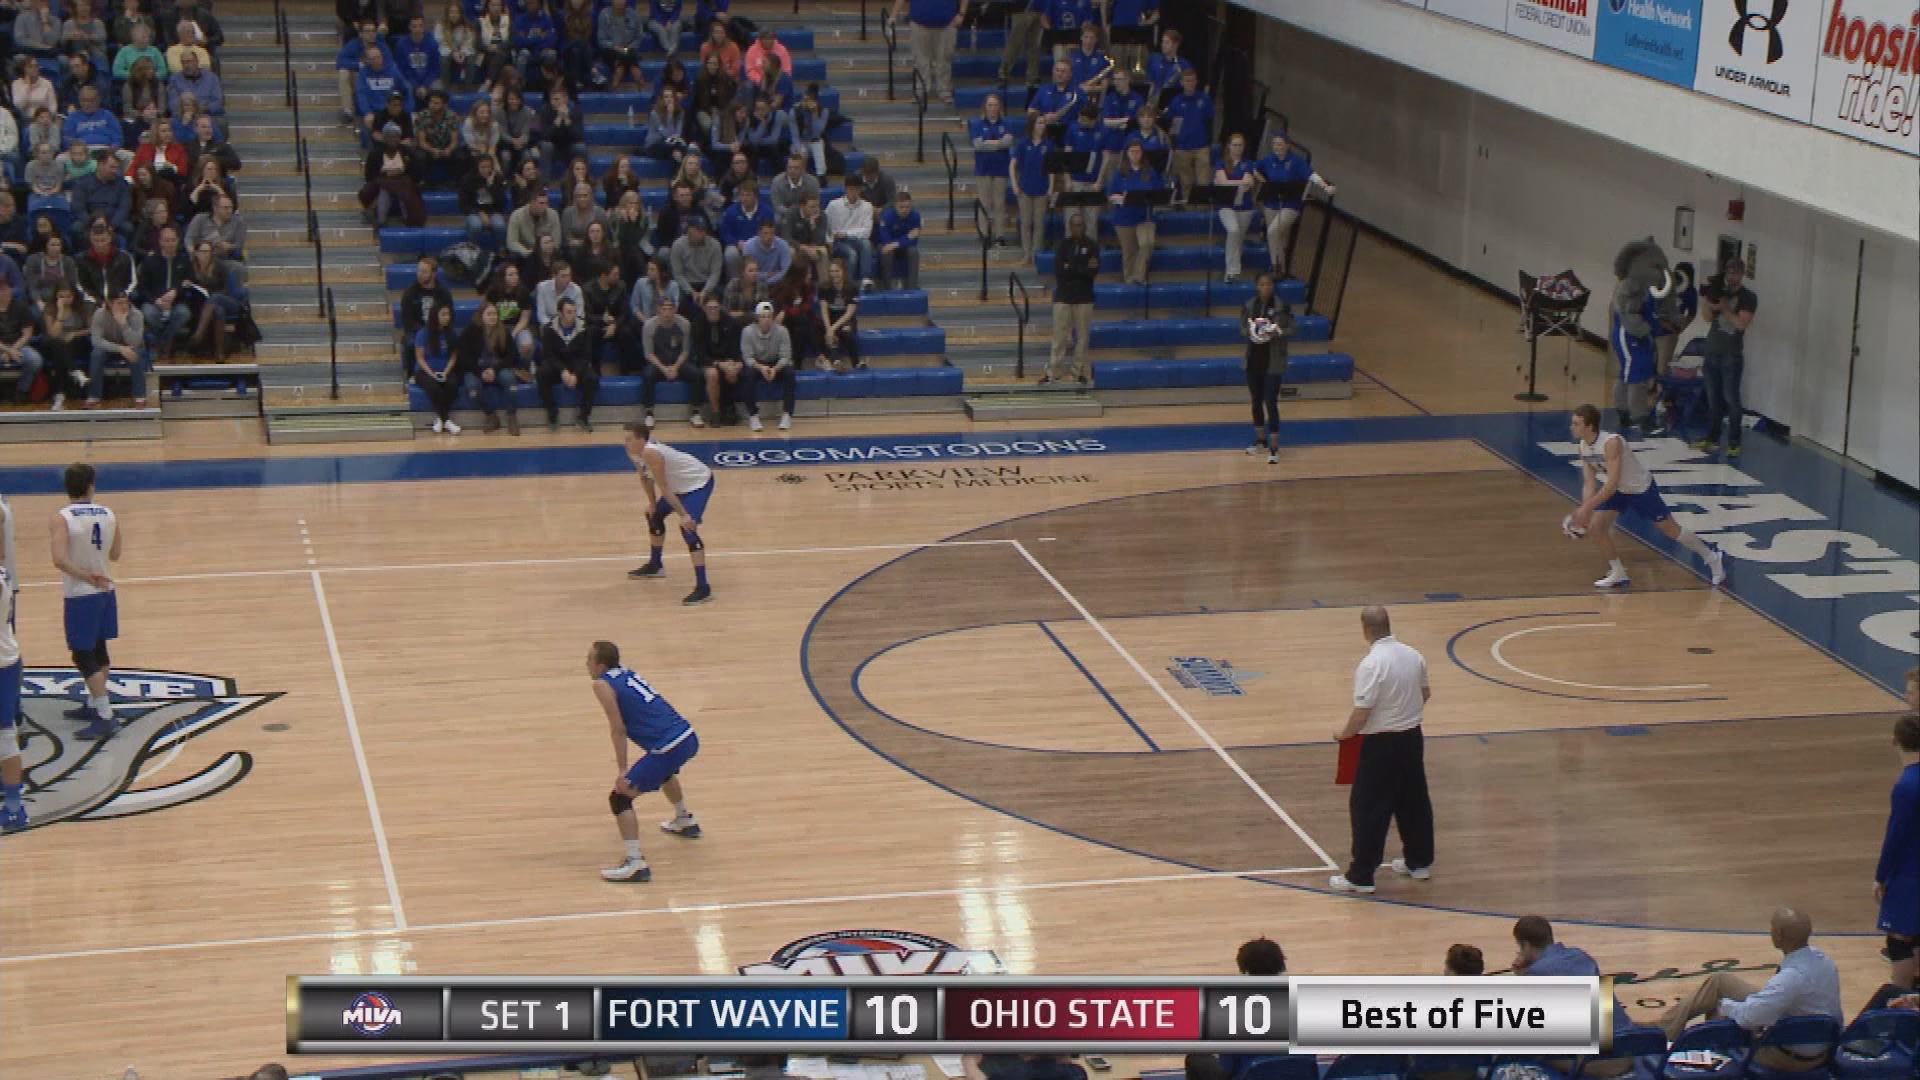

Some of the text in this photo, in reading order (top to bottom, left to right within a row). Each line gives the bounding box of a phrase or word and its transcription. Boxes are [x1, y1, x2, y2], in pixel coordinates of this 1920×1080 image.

[1656, 4, 1693, 31] Network
[1823, 0, 1920, 75] hoosi
[1715, 65, 1791, 98] UNDER ARMOUR
[713, 440, 1107, 467] @GOMASTODONS
[824, 465, 1020, 483] PARKVIEW
[834, 475, 1100, 492] SPORTS MEDICINE
[91, 521, 103, 551] 4
